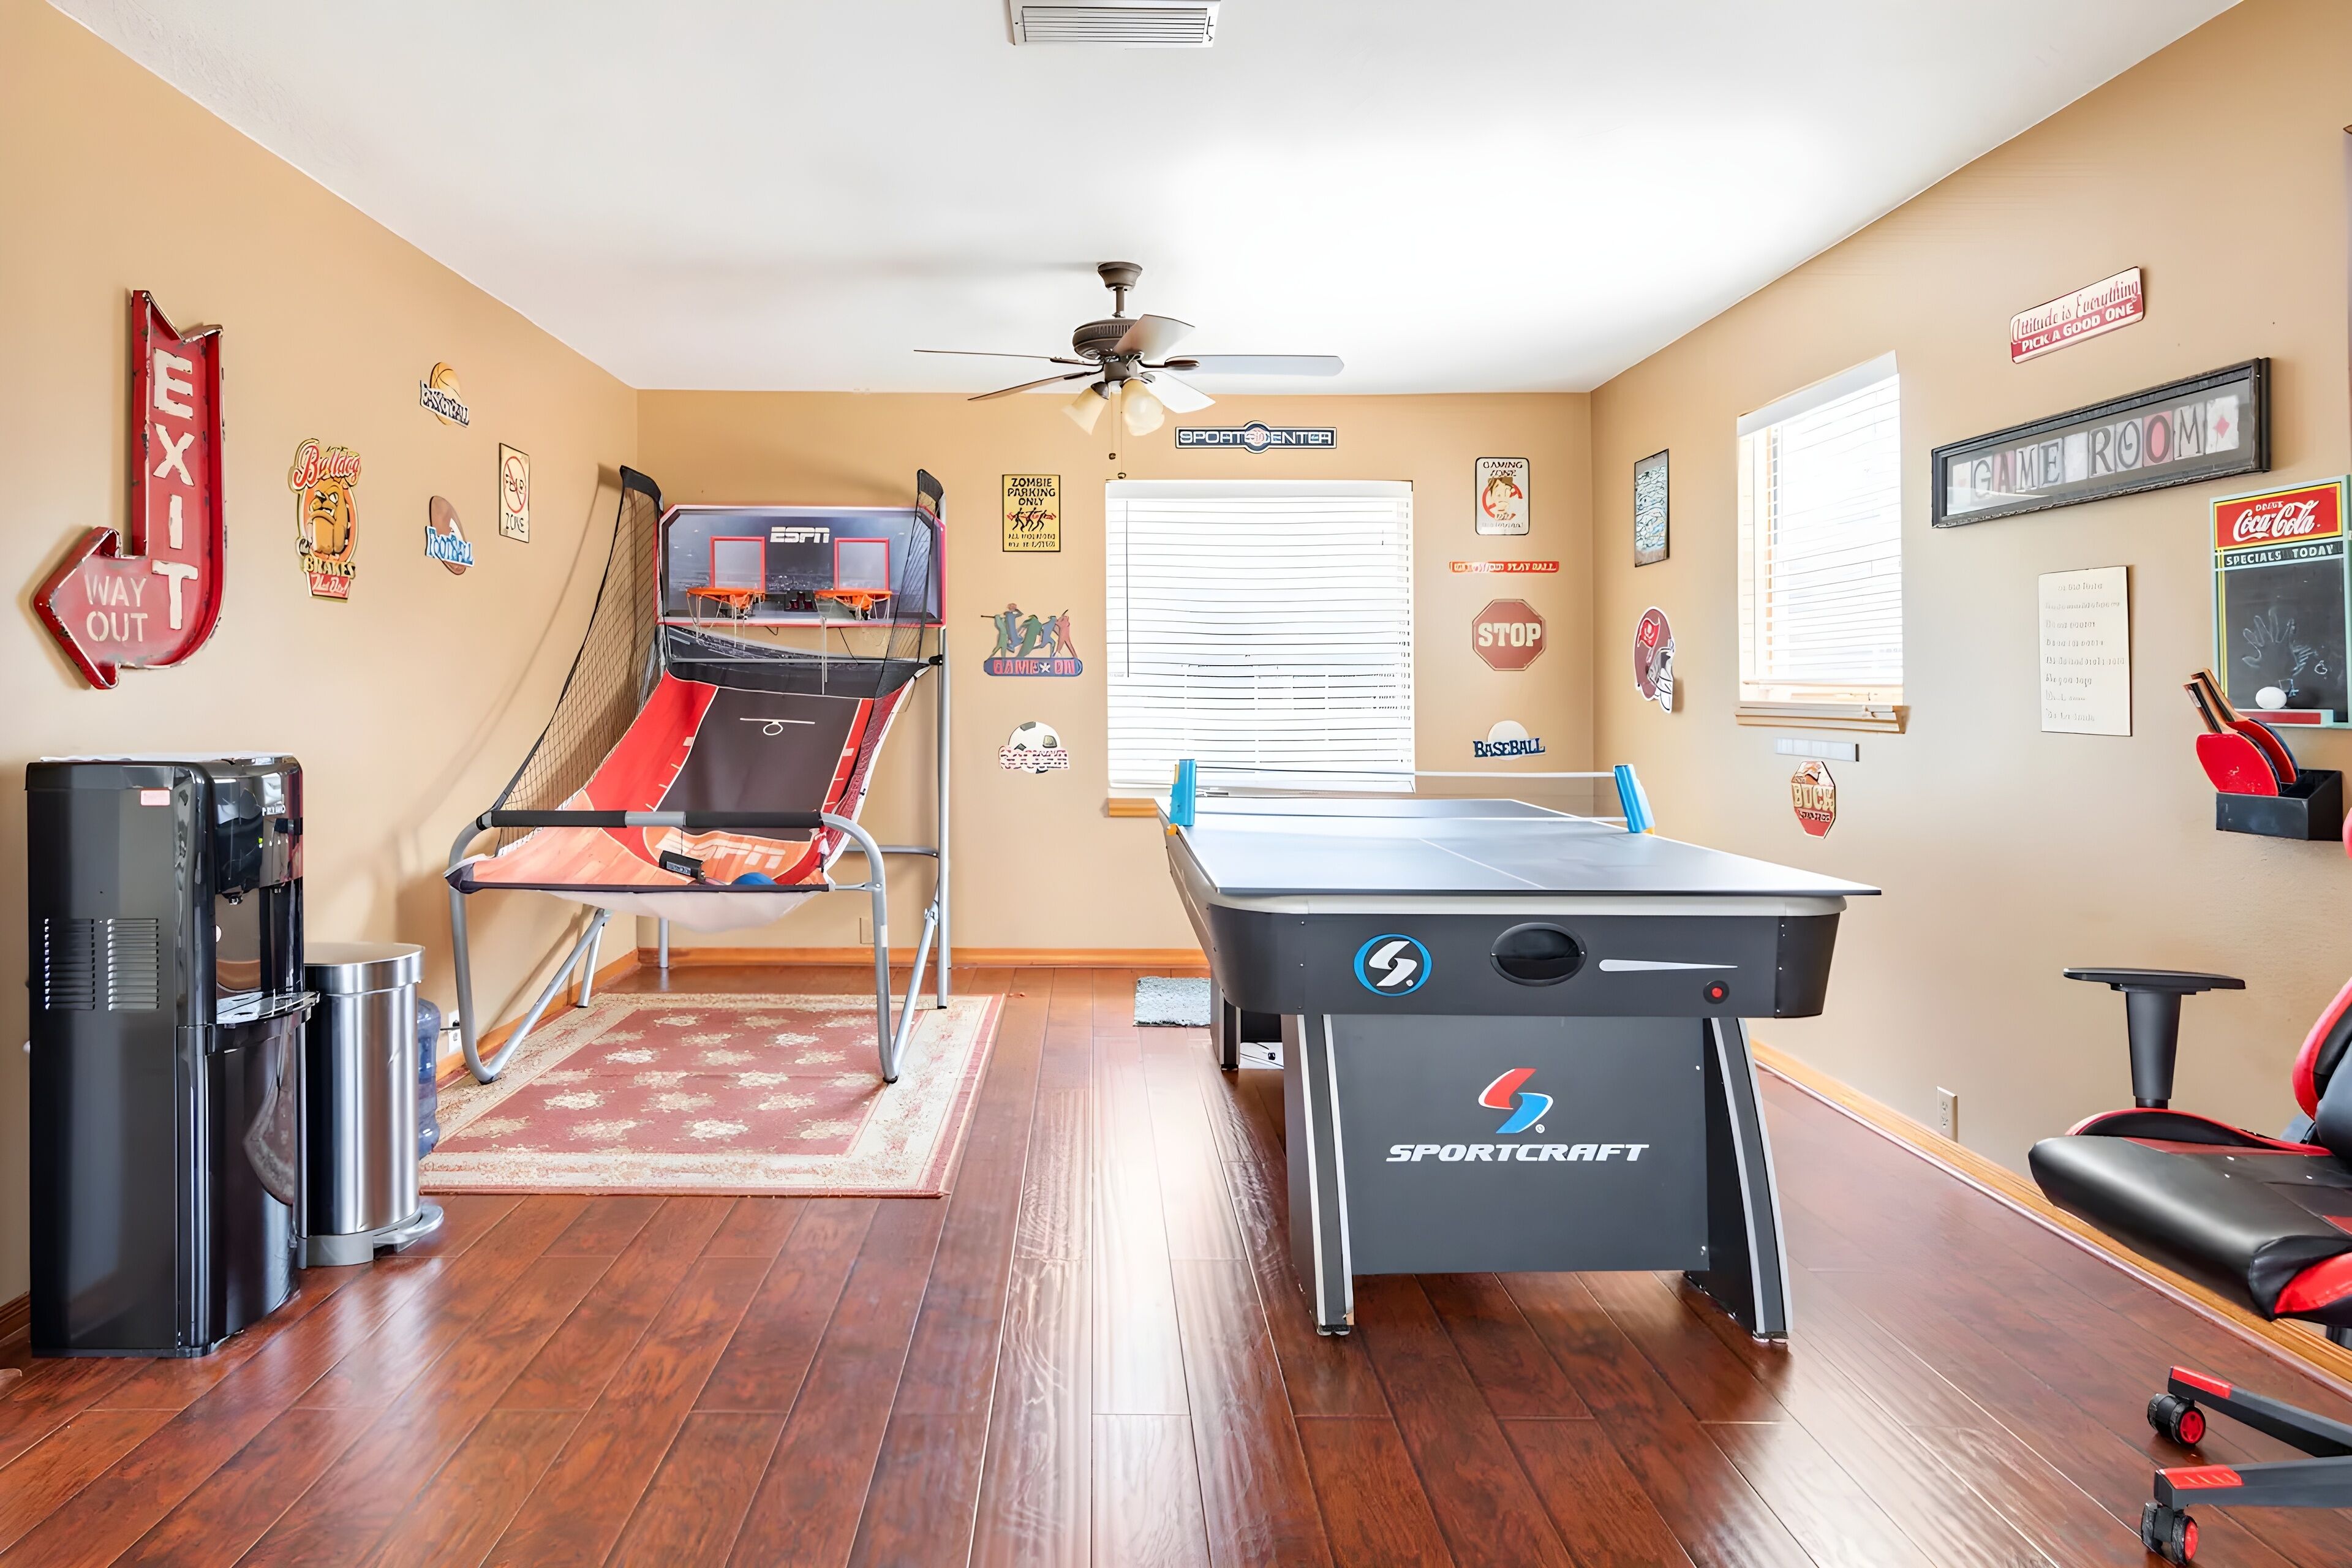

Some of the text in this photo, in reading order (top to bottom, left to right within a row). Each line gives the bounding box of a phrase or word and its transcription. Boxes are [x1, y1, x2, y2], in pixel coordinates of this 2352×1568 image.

[2062, 304, 2071, 321] is
[2076, 279, 2139, 318] Everything
[2022, 302, 2135, 352] PICK A GOOD ONE
[1974, 405, 2203, 498] GAME ROOM
[151, 347, 198, 630] EXIT
[1008, 488, 1055, 497] PARKING
[1011, 478, 1052, 487] ZOMBIE
[2233, 500, 2320, 541] Coca-Cola
[770, 527, 830, 543] ESPN
[2226, 544, 2334, 566] SPECIALS TODAY
[85, 575, 148, 607] WAY
[86, 611, 148, 643] OUT
[1479, 622, 1541, 647] STOP
[1473, 737, 1546, 758] BASEBALL
[1386, 1144, 1649, 1162] SPORTCRAFT
